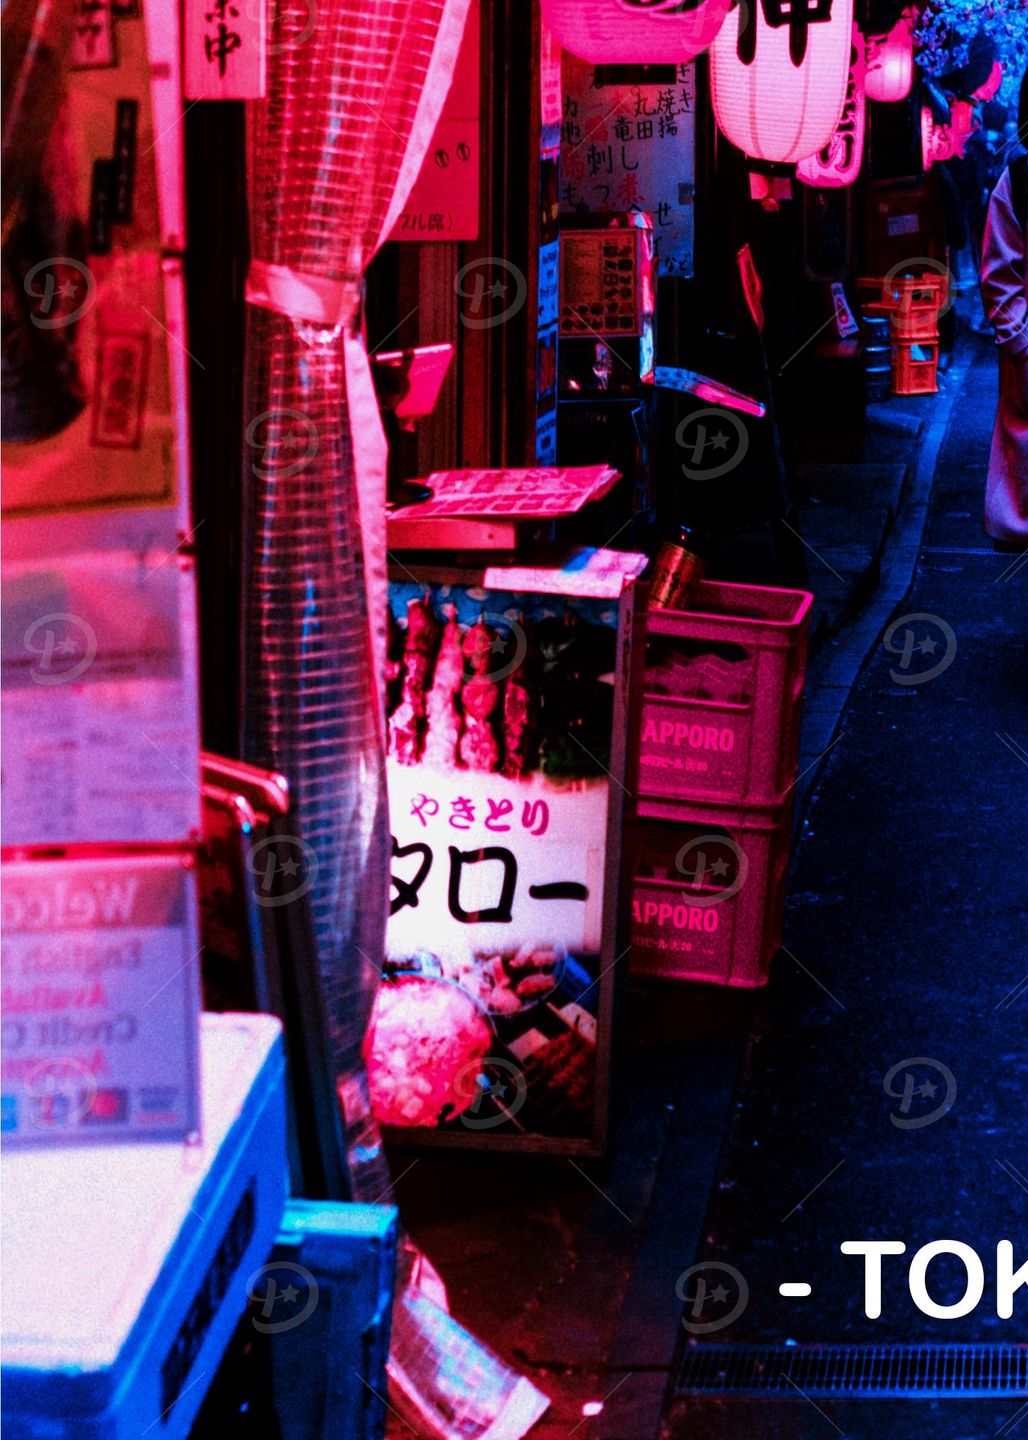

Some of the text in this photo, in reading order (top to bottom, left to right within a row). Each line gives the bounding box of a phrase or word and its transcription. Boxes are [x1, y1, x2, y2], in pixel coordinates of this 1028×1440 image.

[641, 720, 734, 752] APPORO
[409, 792, 550, 837] やきとり
[390, 835, 590, 924] タロー
[632, 900, 719, 933] APPORO
